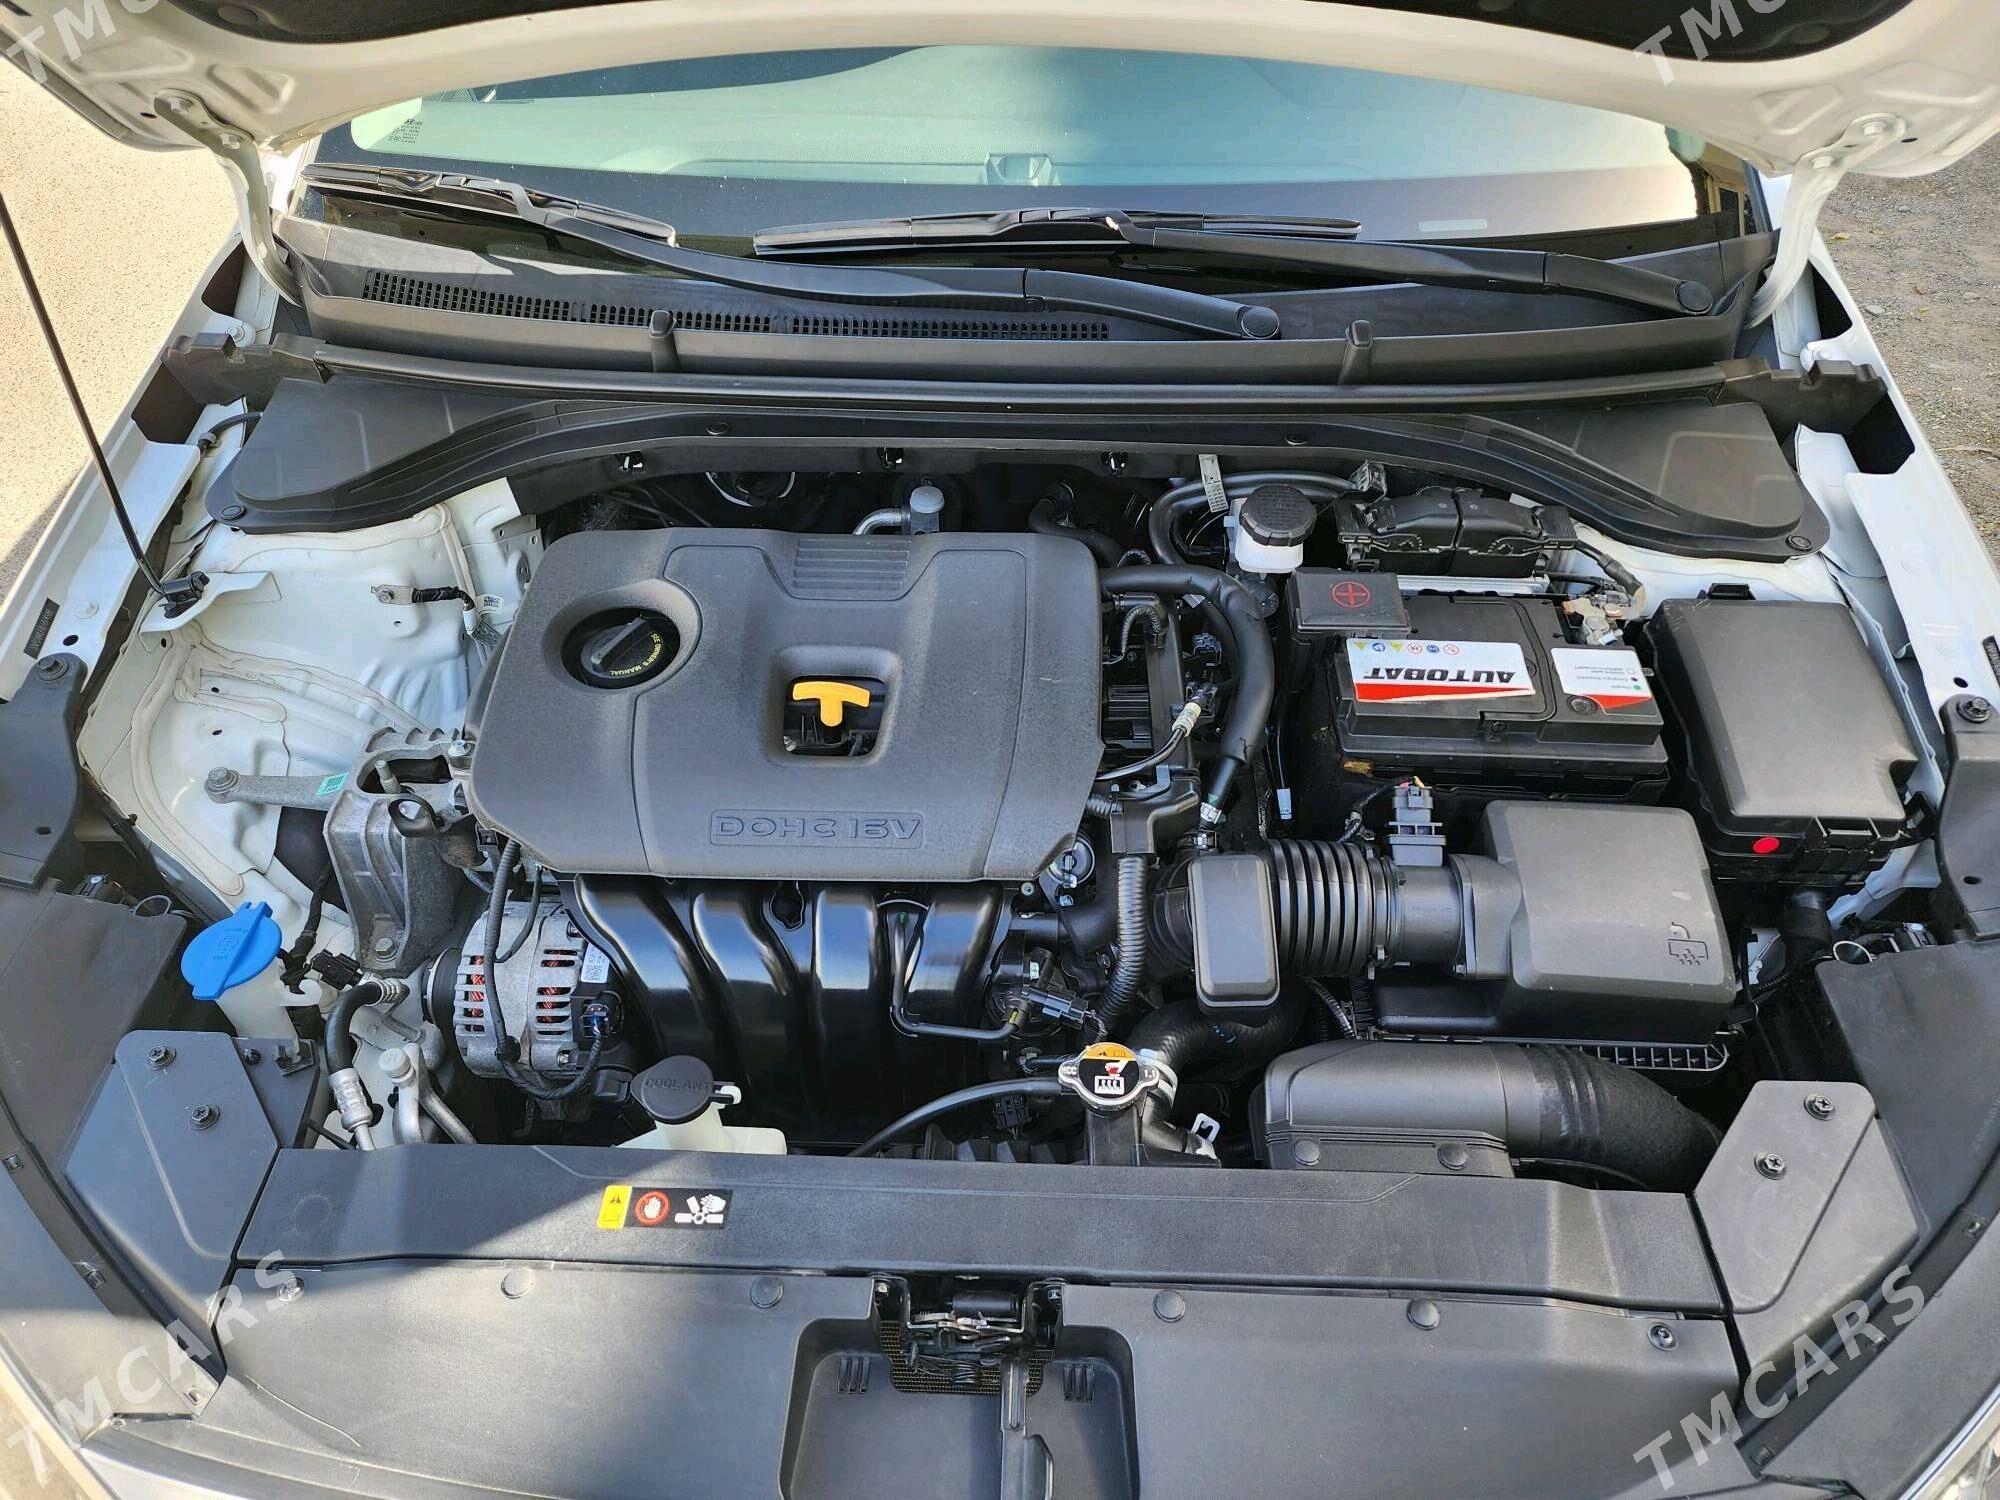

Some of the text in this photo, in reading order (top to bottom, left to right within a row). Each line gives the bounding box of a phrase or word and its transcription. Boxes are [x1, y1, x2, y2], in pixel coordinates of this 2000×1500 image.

[610, 665, 642, 676] MANUAL
[1364, 667, 1517, 684] AUTOBAT
[715, 816, 921, 840] DOHC 16V
